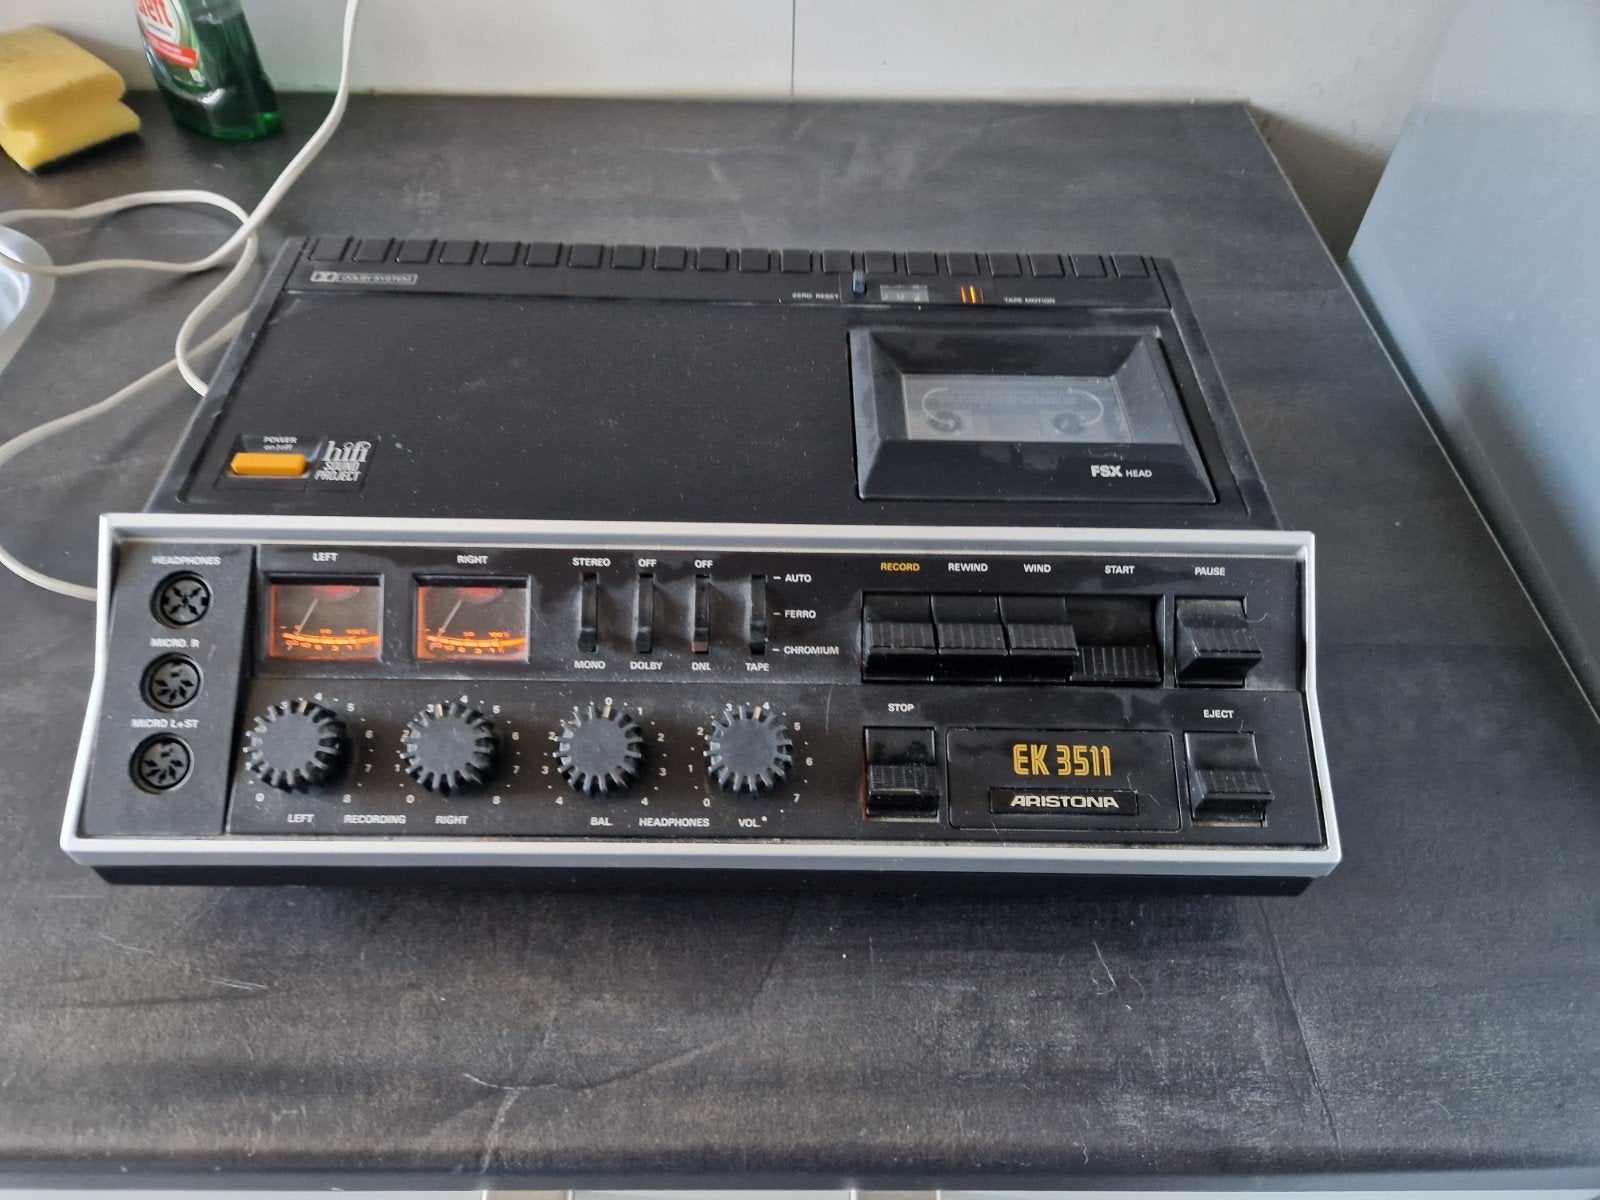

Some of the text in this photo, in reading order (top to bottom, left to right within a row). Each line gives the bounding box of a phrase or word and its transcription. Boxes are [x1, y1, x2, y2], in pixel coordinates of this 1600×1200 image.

[263, 436, 297, 444] POWER
[314, 470, 361, 482] PROJECT
[1090, 464, 1153, 478] FSX HEAD
[151, 556, 222, 566] HEADPHONES
[312, 552, 338, 563] LEFT
[456, 554, 489, 565] RIGHT
[572, 557, 611, 567] STEREO
[637, 558, 657, 569] OFF
[694, 559, 714, 569] OFF
[880, 561, 921, 572] RECORD
[947, 562, 989, 573] REWIND
[1023, 563, 1052, 574] WIND
[1104, 564, 1135, 575] START
[1194, 566, 1226, 577] PAUSE
[784, 573, 812, 583] AUTO
[784, 609, 817, 619] FERRO
[190, 639, 200, 648] R
[783, 645, 839, 655] CHROMIUM
[574, 660, 606, 669] MONO
[630, 661, 663, 670] DOLBY
[691, 661, 711, 671] DNL
[745, 662, 769, 672] TAPE
[725, 703, 733, 712] 3
[888, 703, 914, 712] STOP
[1203, 709, 1234, 719] EJECT
[794, 722, 801, 731] 5
[548, 731, 557, 740] 2
[657, 732, 665, 742] 2
[805, 756, 813, 766] 6
[1012, 743, 1112, 777] EK 3511
[541, 765, 549, 775] 3
[659, 767, 667, 776] 3
[688, 764, 693, 773] 1
[641, 797, 649, 806] 4
[702, 798, 711, 807] 0
[793, 793, 800, 803] 7
[1010, 795, 1119, 808] ARISTONA
[287, 814, 315, 823] LEFT
[343, 815, 407, 824] RECORDING
[434, 815, 469, 824] RIGHT
[638, 818, 710, 827] HEADPHONES
[738, 818, 761, 828] VOL.
